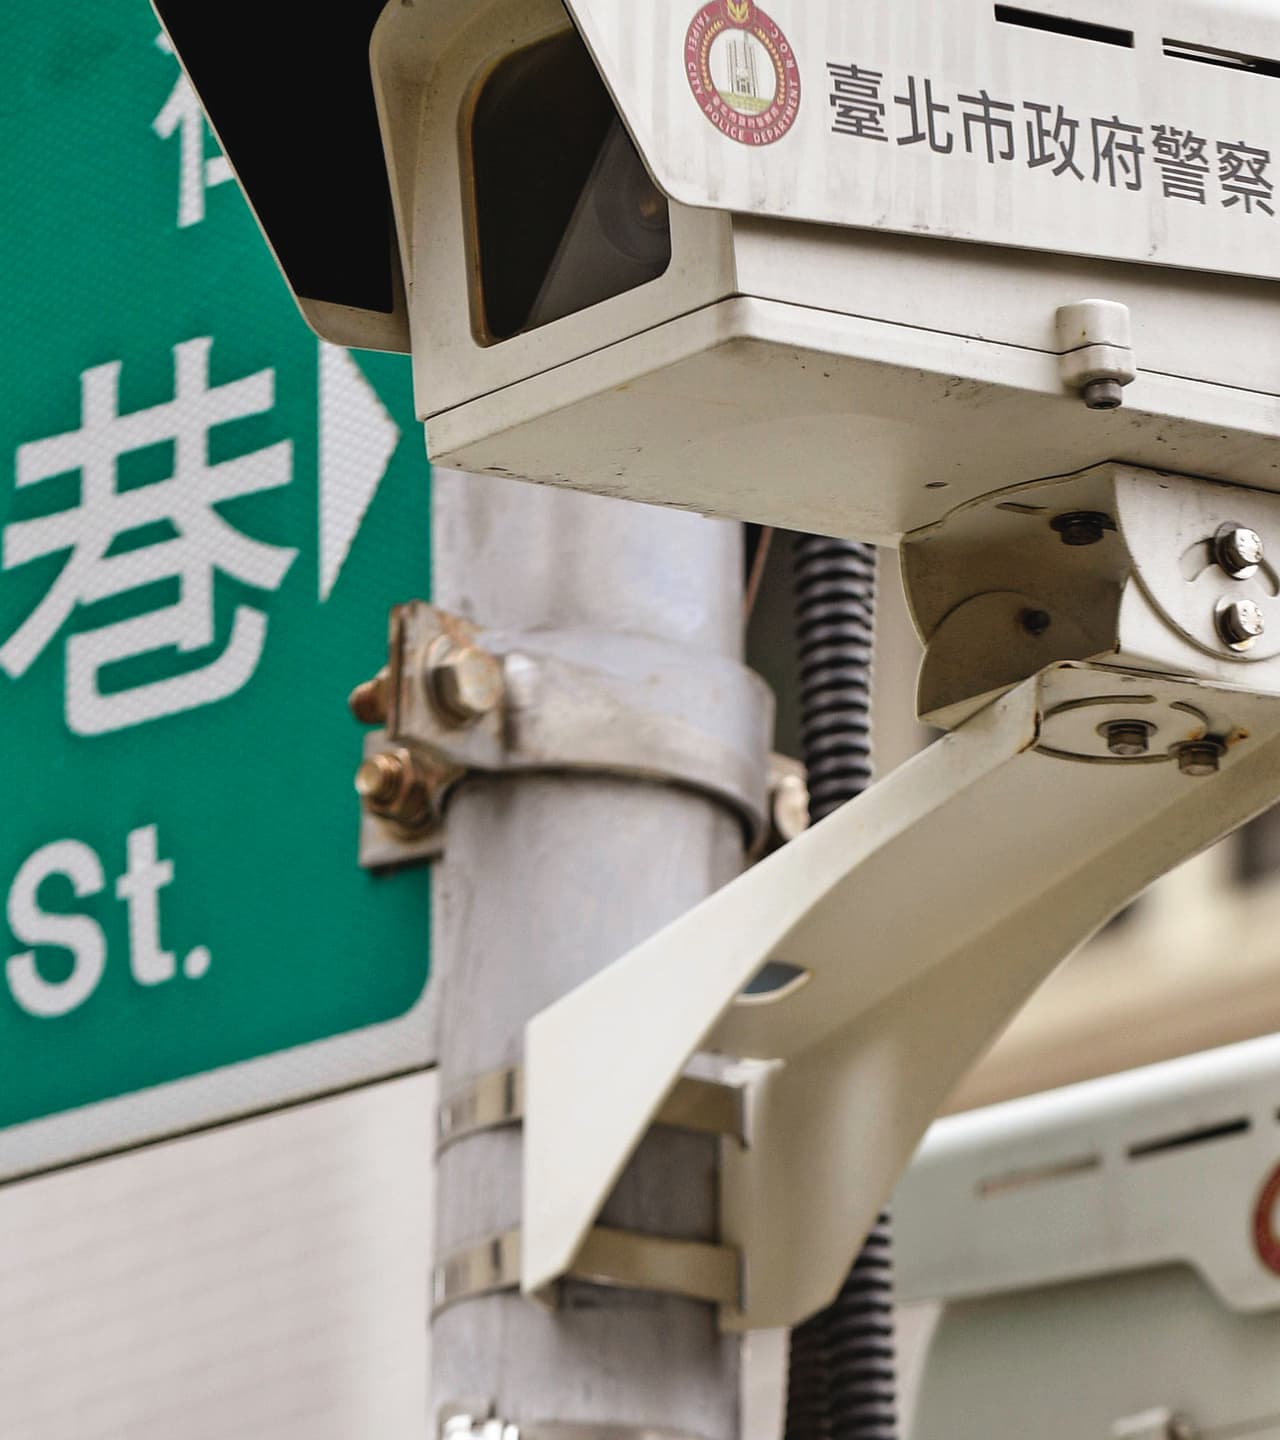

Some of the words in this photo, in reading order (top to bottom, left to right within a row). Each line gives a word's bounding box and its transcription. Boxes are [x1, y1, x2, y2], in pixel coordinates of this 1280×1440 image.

[688, 12, 710, 52] TAIPEI
[688, 62, 705, 96] CITY
[705, 104, 747, 142] POLICE
[753, 81, 799, 145] DEPARTMENT
[5, 825, 211, 1018] St.
